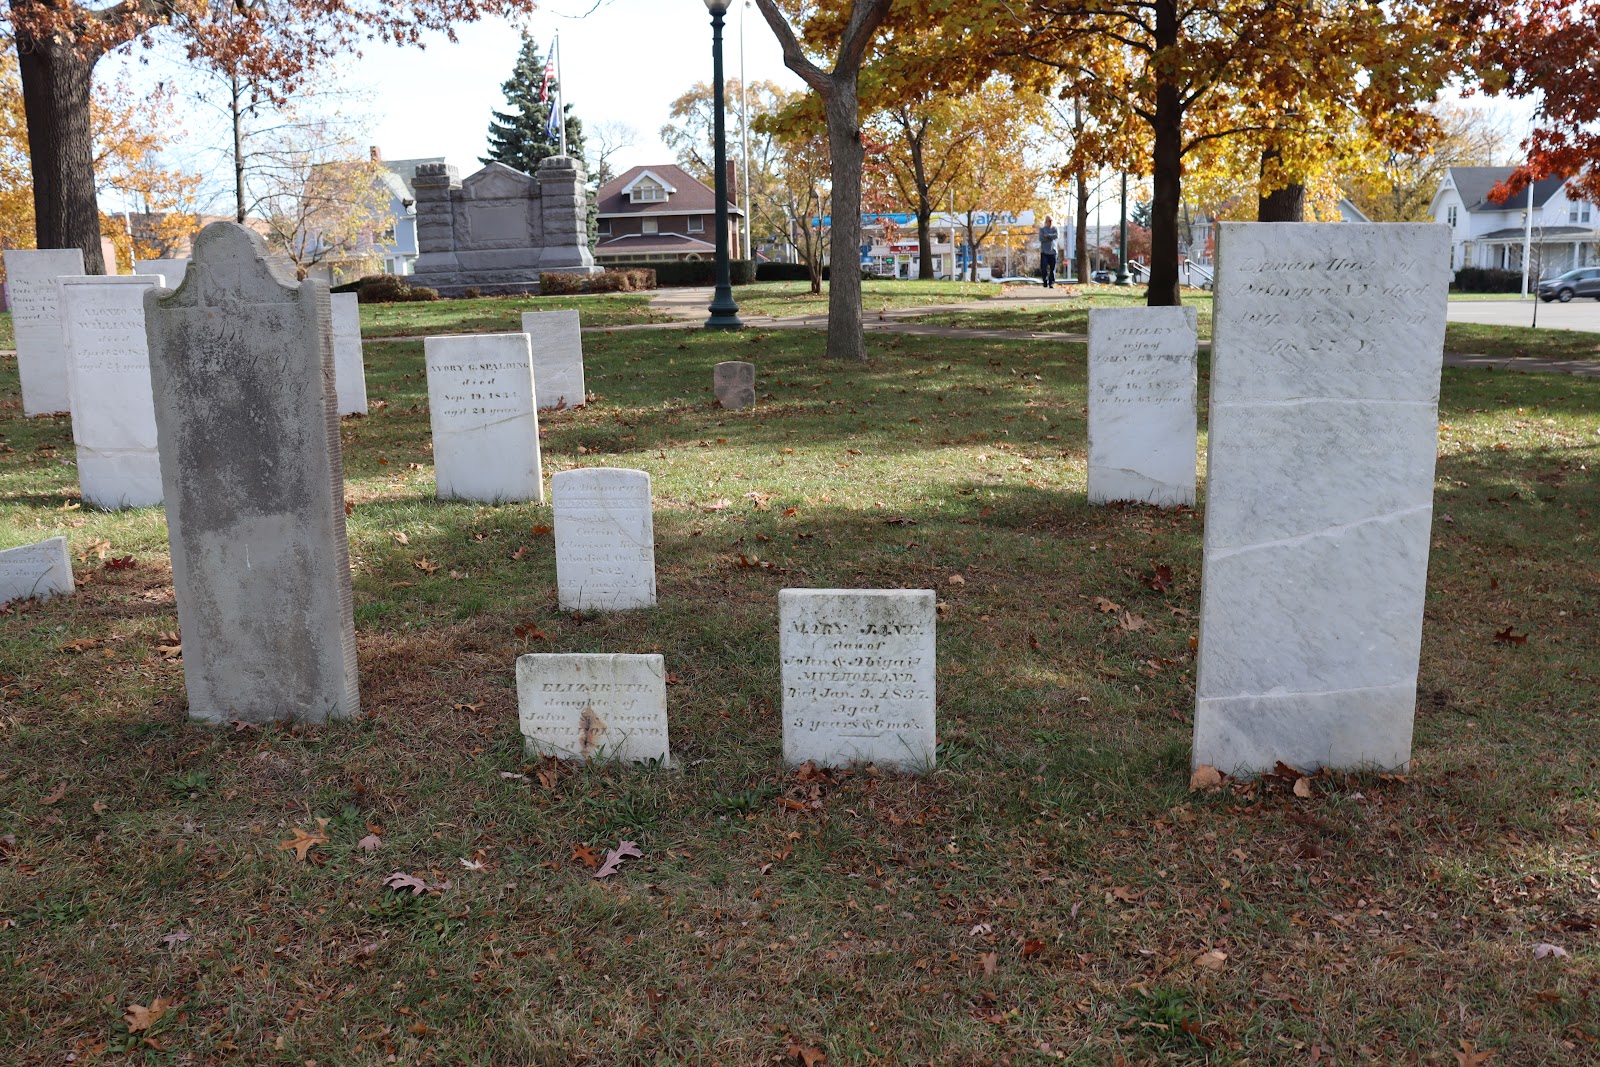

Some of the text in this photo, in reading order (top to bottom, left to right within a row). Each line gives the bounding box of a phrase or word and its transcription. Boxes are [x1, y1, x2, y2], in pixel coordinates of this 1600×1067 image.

[82, 308, 127, 316] ALONZO
[98, 335, 130, 343] died
[1150, 341, 1162, 351] of
[429, 362, 529, 373] AVORY G. SPALDING
[1126, 368, 1161, 376] died
[462, 378, 496, 386] died
[576, 527, 614, 537] Calvin
[560, 540, 612, 549] Clarissa
[584, 553, 609, 562] died
[784, 655, 922, 671] John & Abigail
[785, 687, 816, 699] Died
[819, 687, 855, 700] Jan.
[878, 687, 929, 700] 1837.
[621, 698, 638, 711] of
[832, 704, 881, 718] Aged
[525, 711, 566, 722] John
[793, 718, 804, 728] 3
[810, 719, 858, 733] years
[861, 718, 874, 730] &
[875, 719, 885, 730] 6
